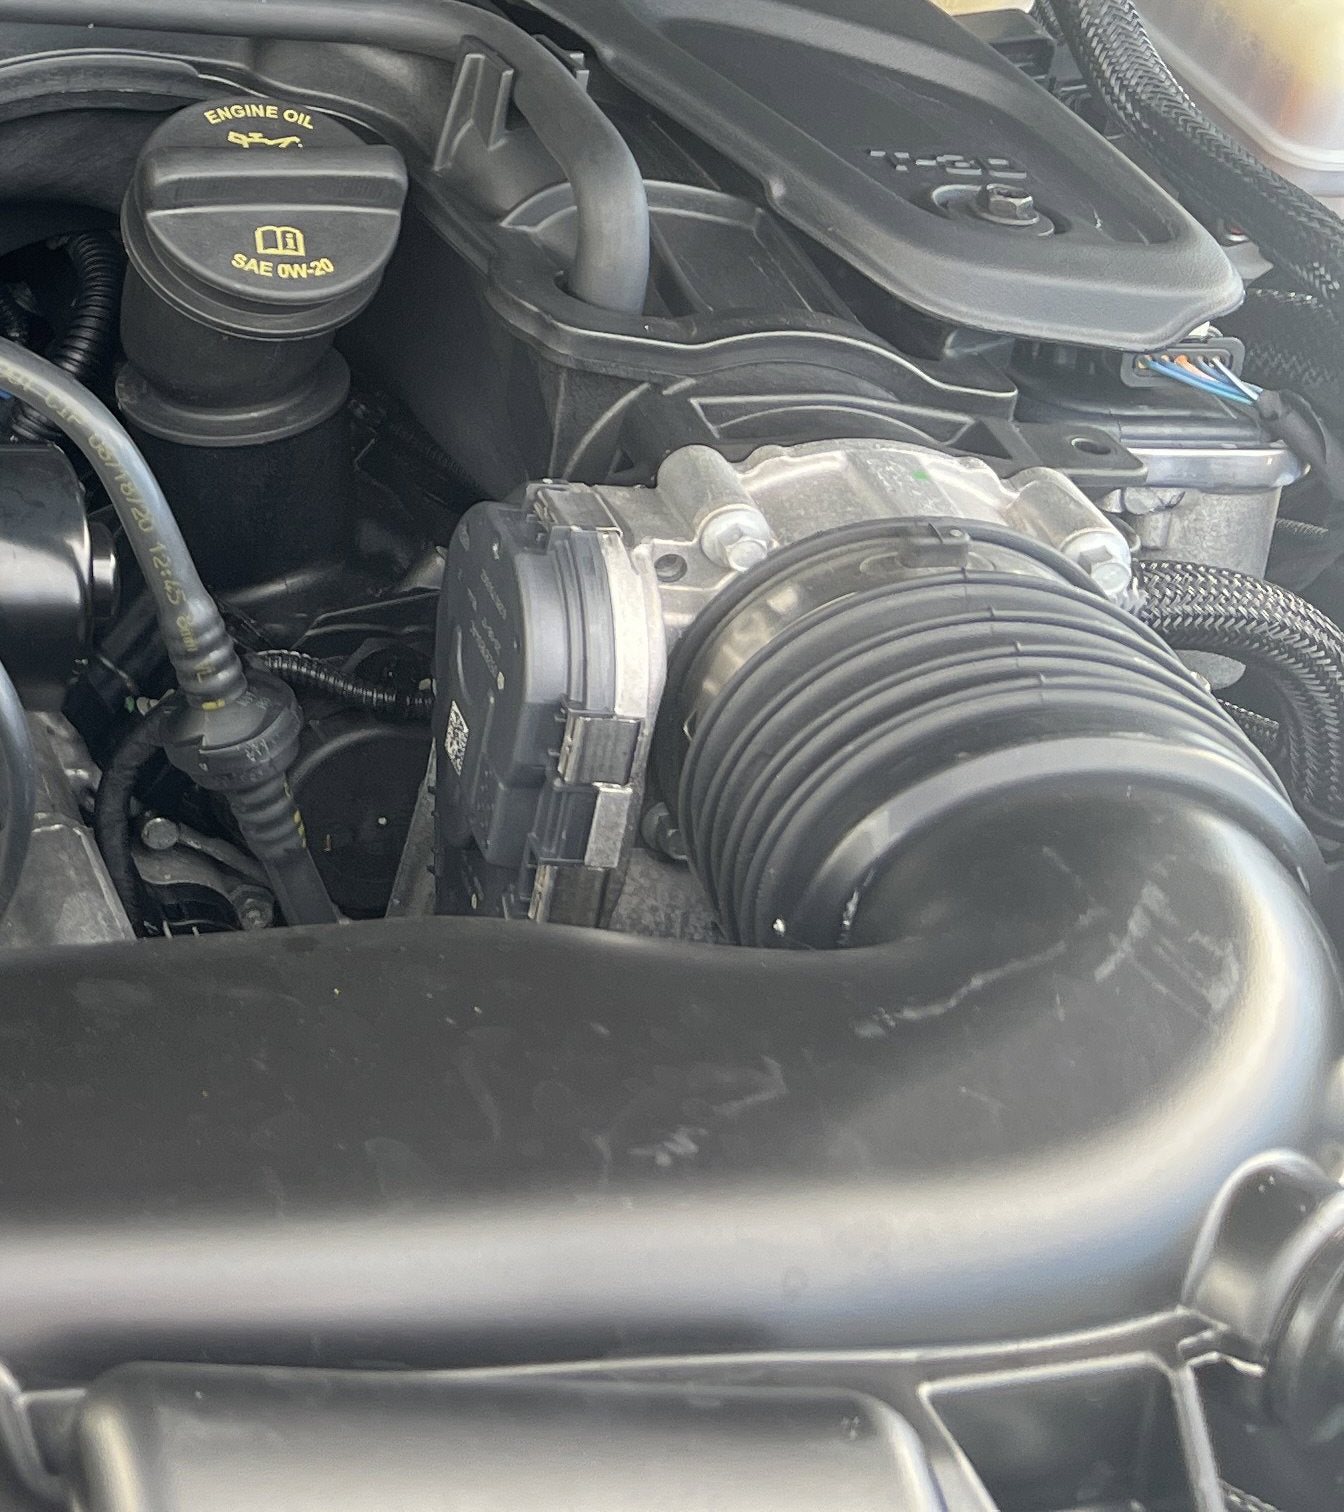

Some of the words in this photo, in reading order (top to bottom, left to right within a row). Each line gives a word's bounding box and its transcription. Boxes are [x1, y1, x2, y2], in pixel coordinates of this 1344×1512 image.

[203, 104, 279, 125] ENGINE
[283, 109, 314, 130] OIL
[231, 253, 273, 277] SAE
[277, 258, 334, 279] 0W-20
